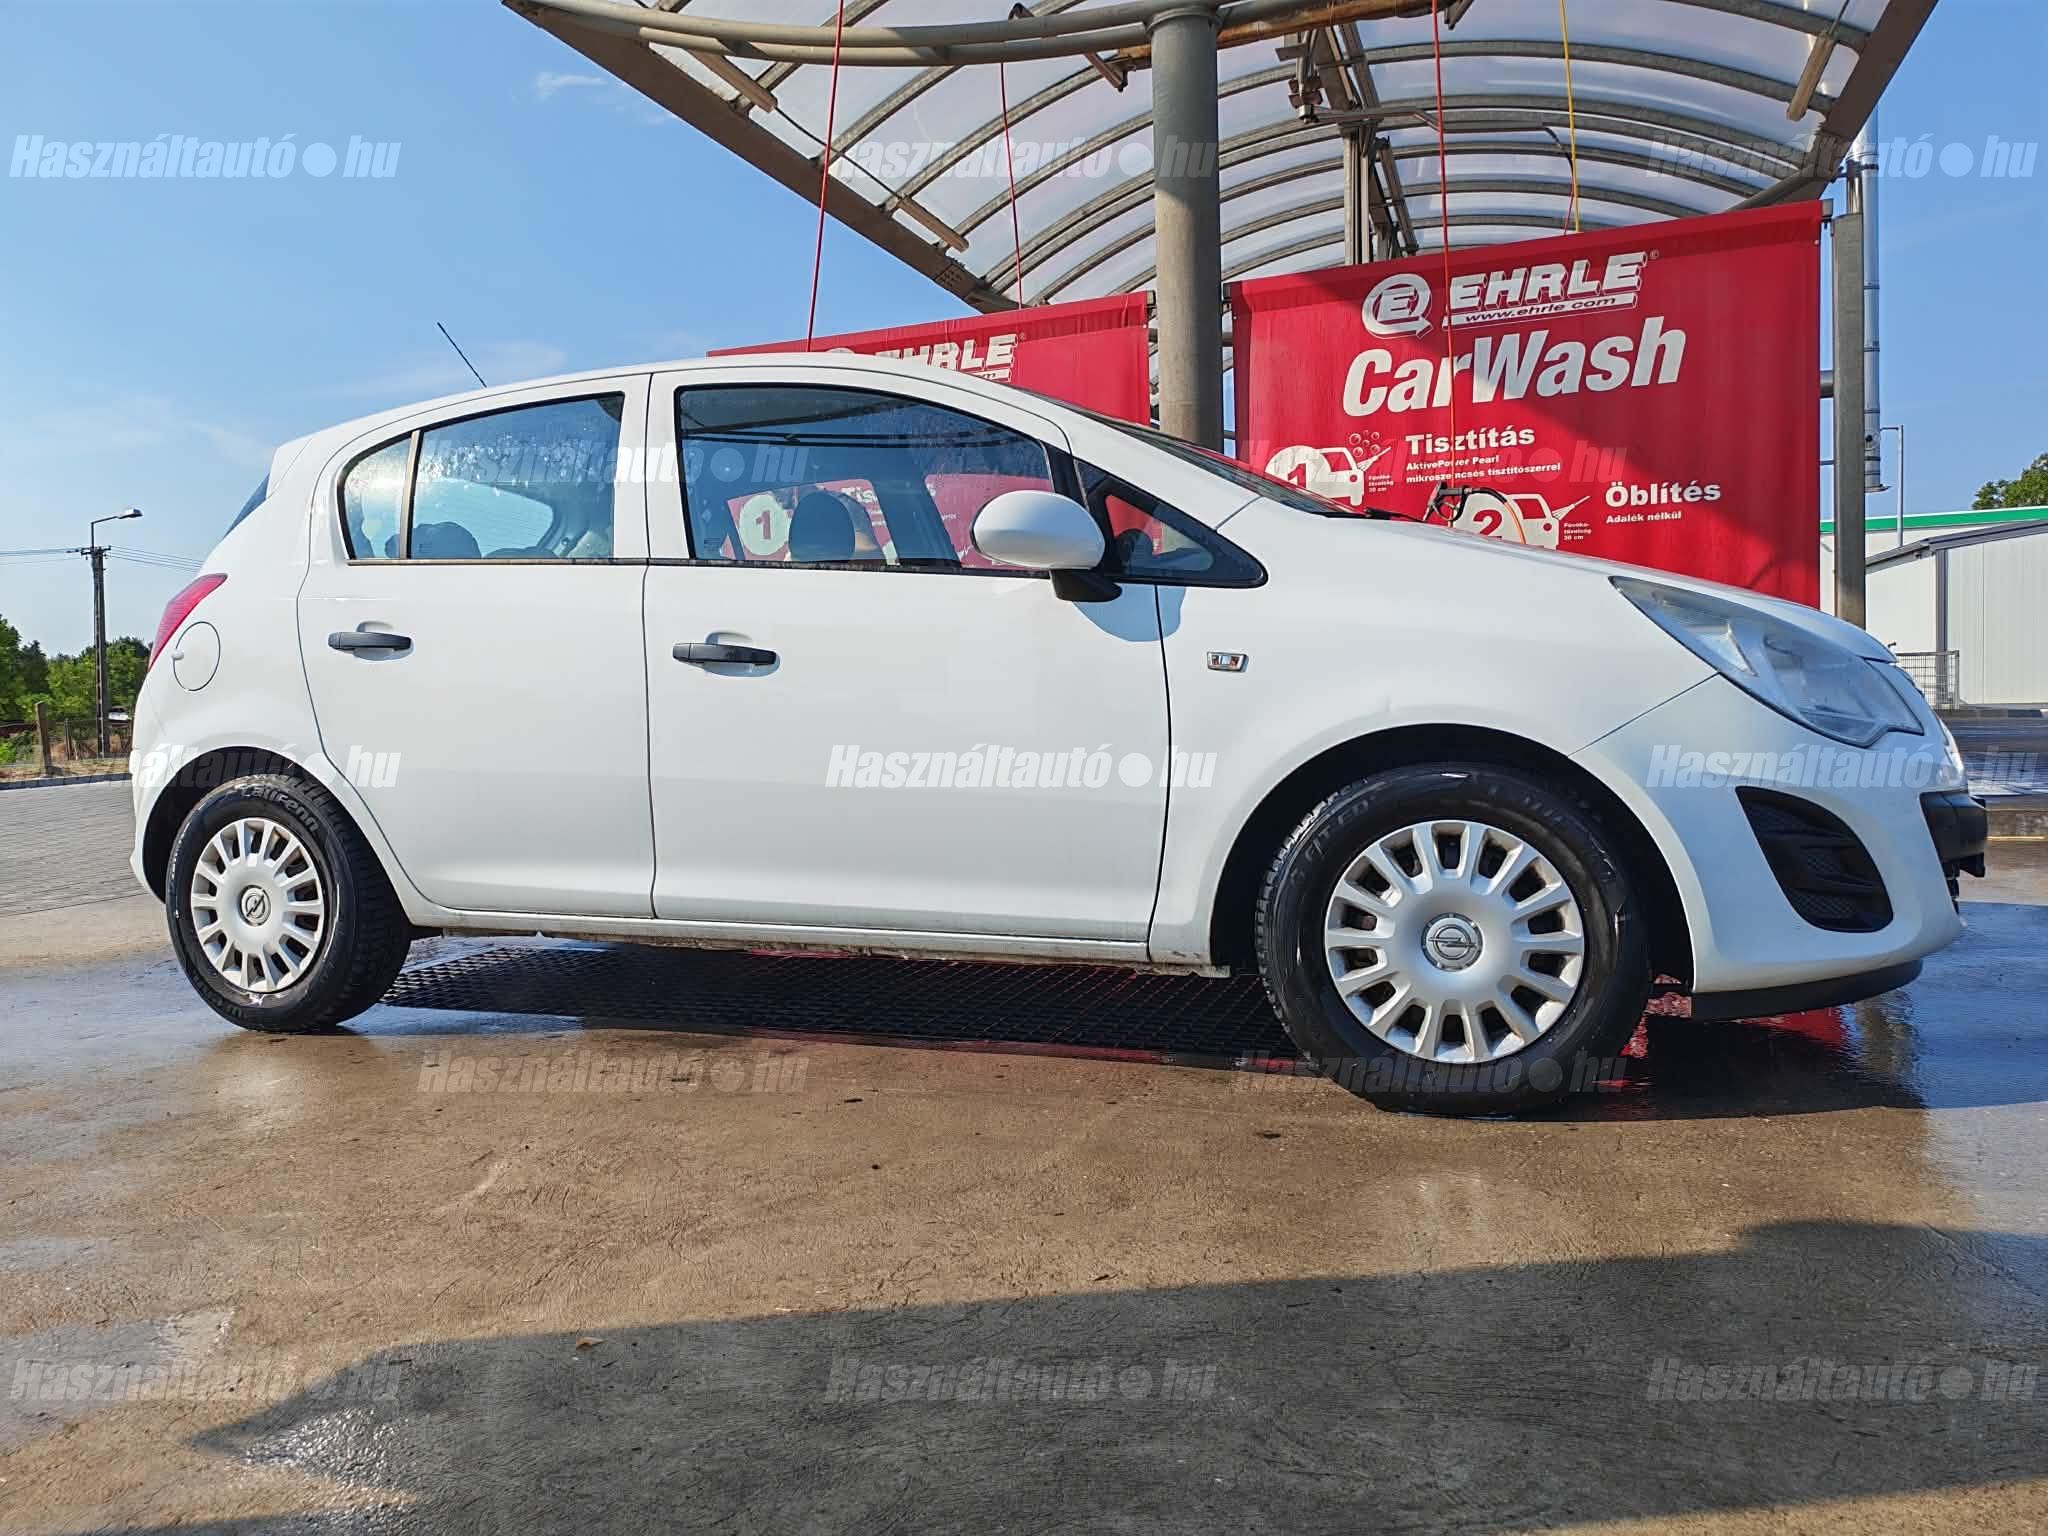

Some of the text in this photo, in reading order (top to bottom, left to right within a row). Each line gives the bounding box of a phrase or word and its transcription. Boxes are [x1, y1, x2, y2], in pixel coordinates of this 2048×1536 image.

[1449, 252, 1647, 309] EHRLE
[1342, 316, 1687, 417] CarWash
[1405, 425, 1536, 455] Tisztítás
[1472, 454, 1499, 465] Pearl
[1605, 480, 1721, 507] Öblítés
[1473, 509, 1503, 539] 2
[1606, 510, 1682, 524] Adalék nélkül
